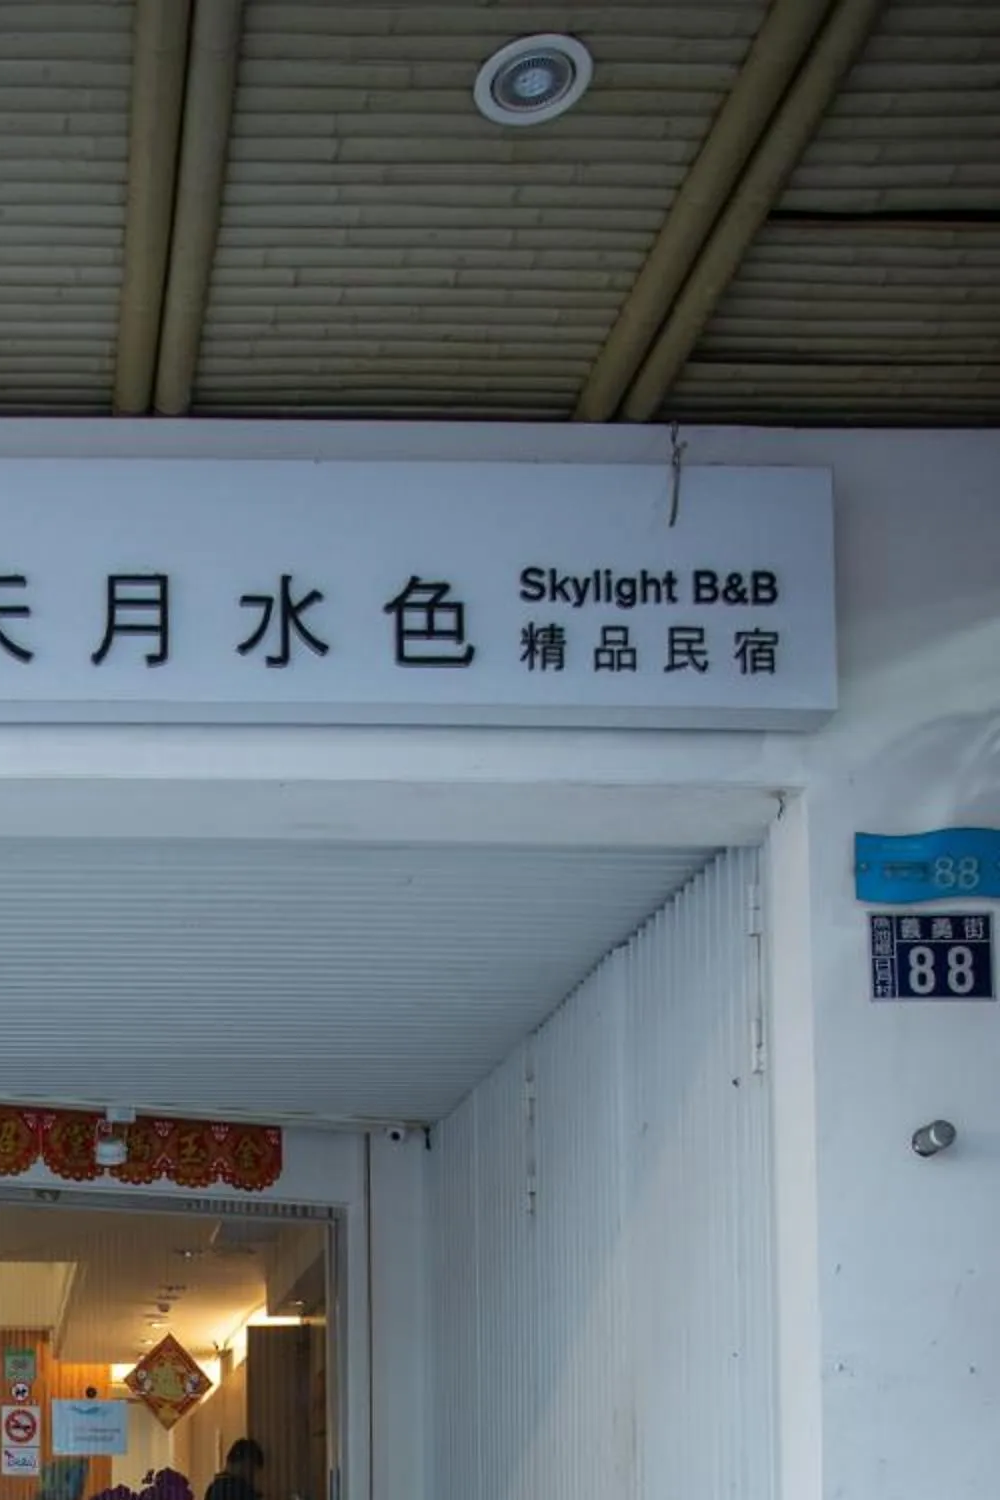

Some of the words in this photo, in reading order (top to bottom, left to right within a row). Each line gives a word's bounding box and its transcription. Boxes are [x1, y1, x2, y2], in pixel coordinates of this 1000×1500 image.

[519, 567, 679, 609] Skylight
[692, 568, 779, 606] B&B
[520, 621, 781, 675] 精品民宿
[934, 856, 980, 890] 88
[908, 945, 975, 994] 88
